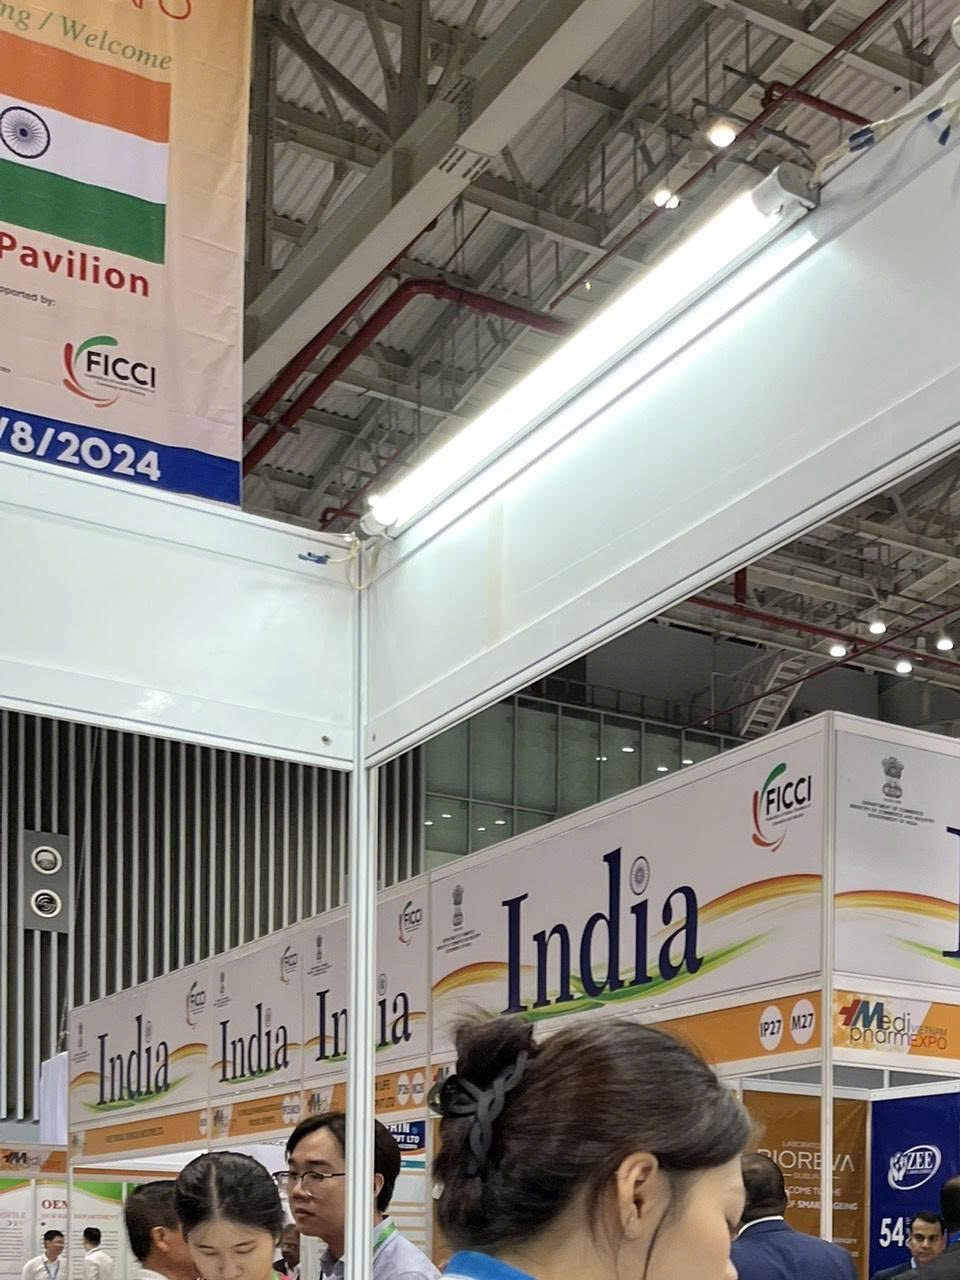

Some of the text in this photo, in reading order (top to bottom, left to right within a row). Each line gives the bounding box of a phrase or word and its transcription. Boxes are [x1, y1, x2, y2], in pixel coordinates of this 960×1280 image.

[61, 15, 172, 70] Welcome
[0, 231, 149, 297] Pavilion
[86, 350, 156, 388] FICCI
[765, 775, 812, 815] FICCI
[502, 847, 704, 1015] India
[97, 1014, 169, 1106] India
[218, 1003, 289, 1083] India
[911, 1034, 948, 1050] EXPO
[907, 1151, 933, 1170] ZEE
[880, 1217, 905, 1247] 54
